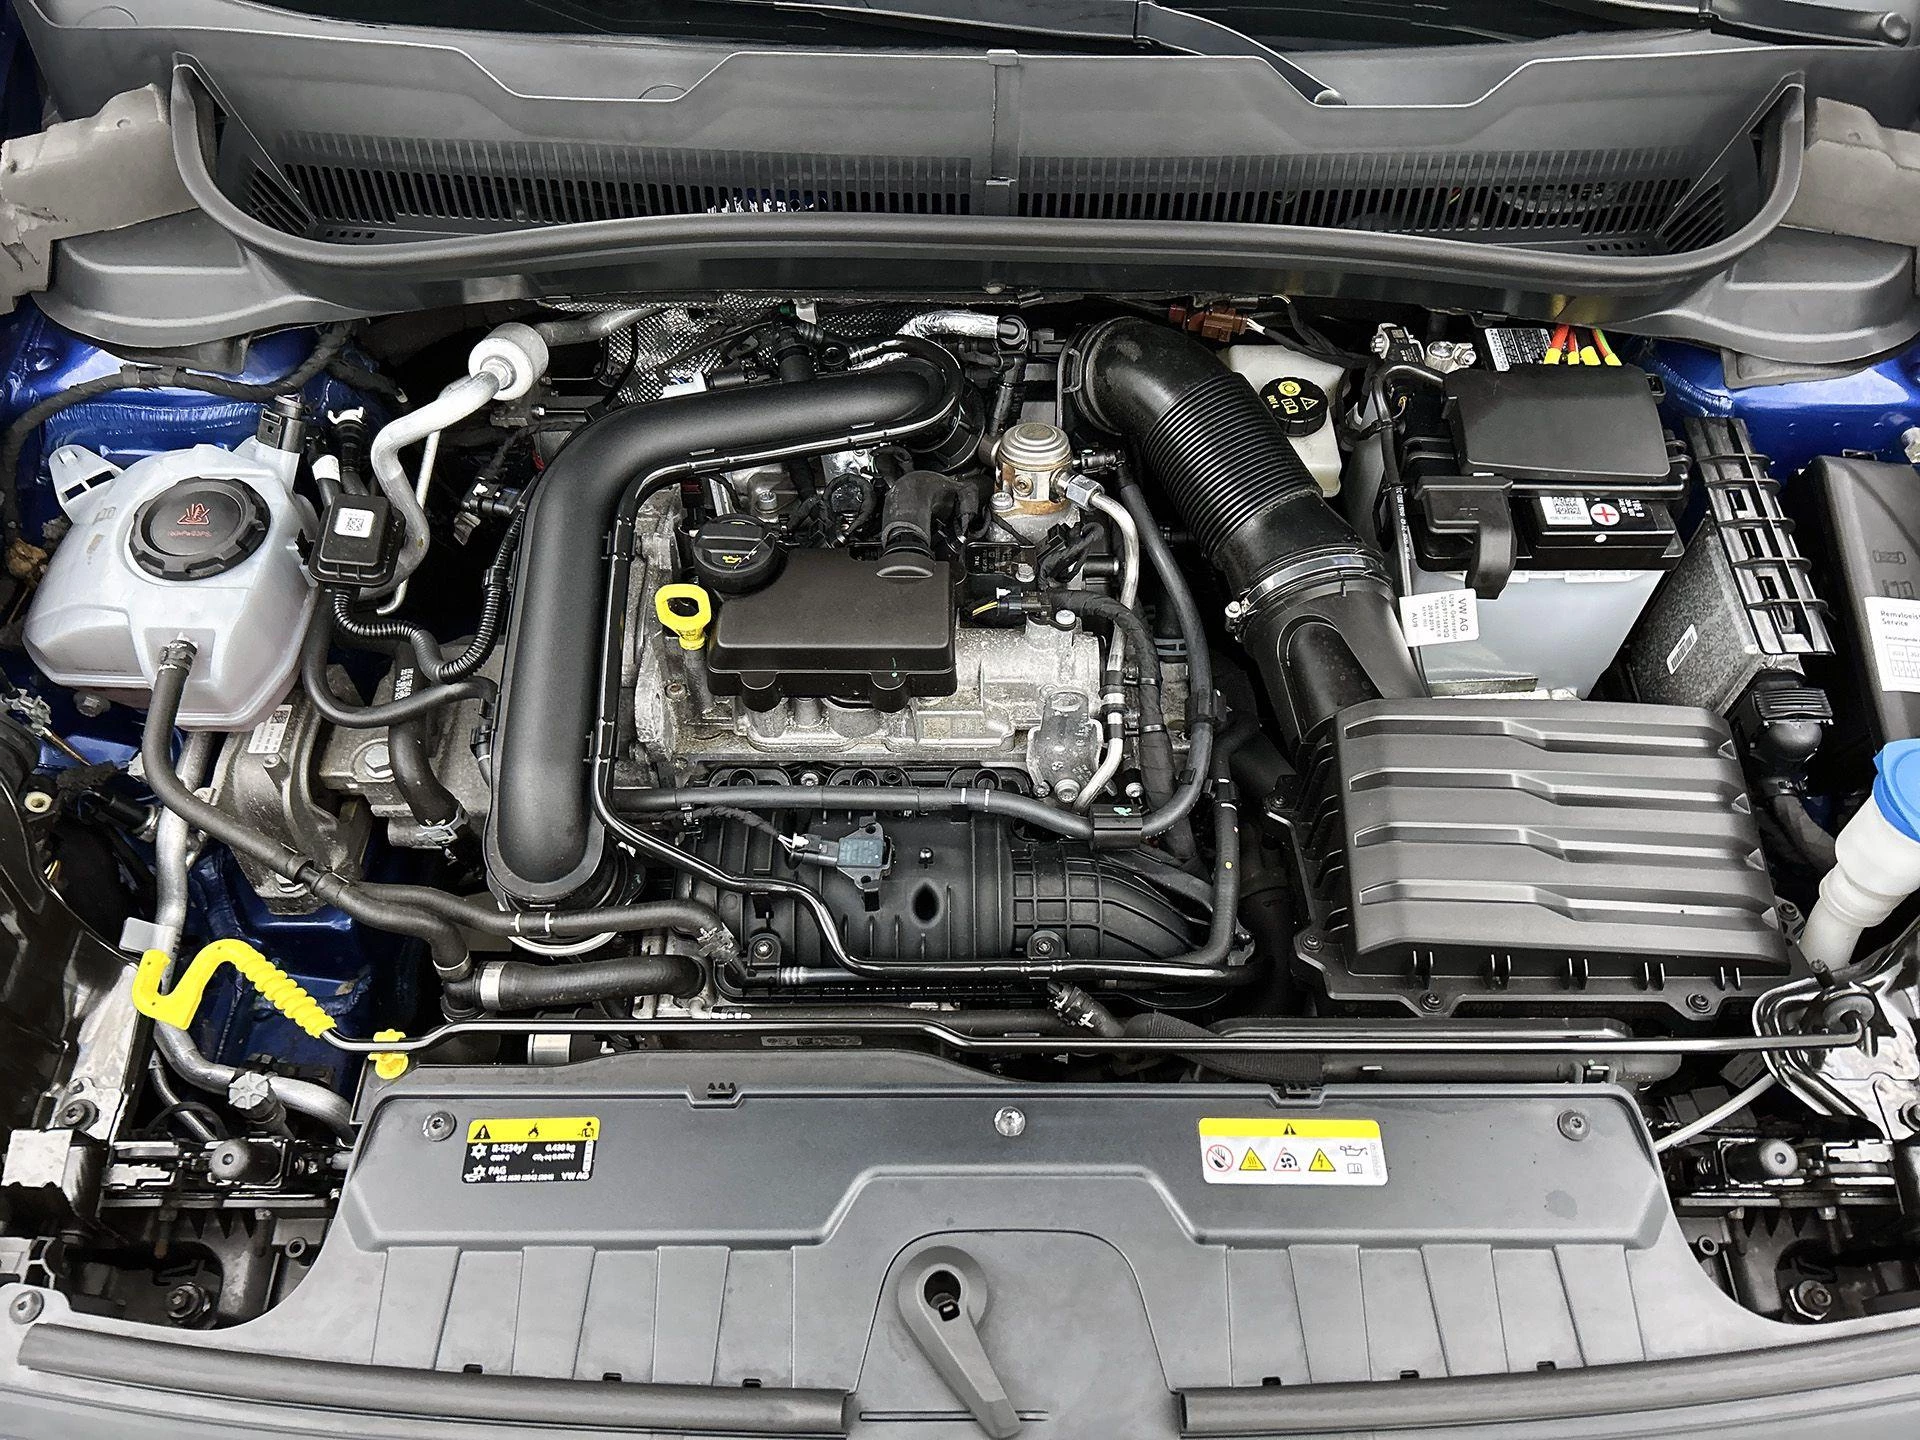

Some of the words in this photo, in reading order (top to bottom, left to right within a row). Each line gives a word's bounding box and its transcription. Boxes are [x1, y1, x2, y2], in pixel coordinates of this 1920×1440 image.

[1458, 597, 1467, 615] VW
[1459, 617, 1469, 632] AG
[1881, 617, 1909, 627] Service
[560, 1171, 577, 1181] VW
